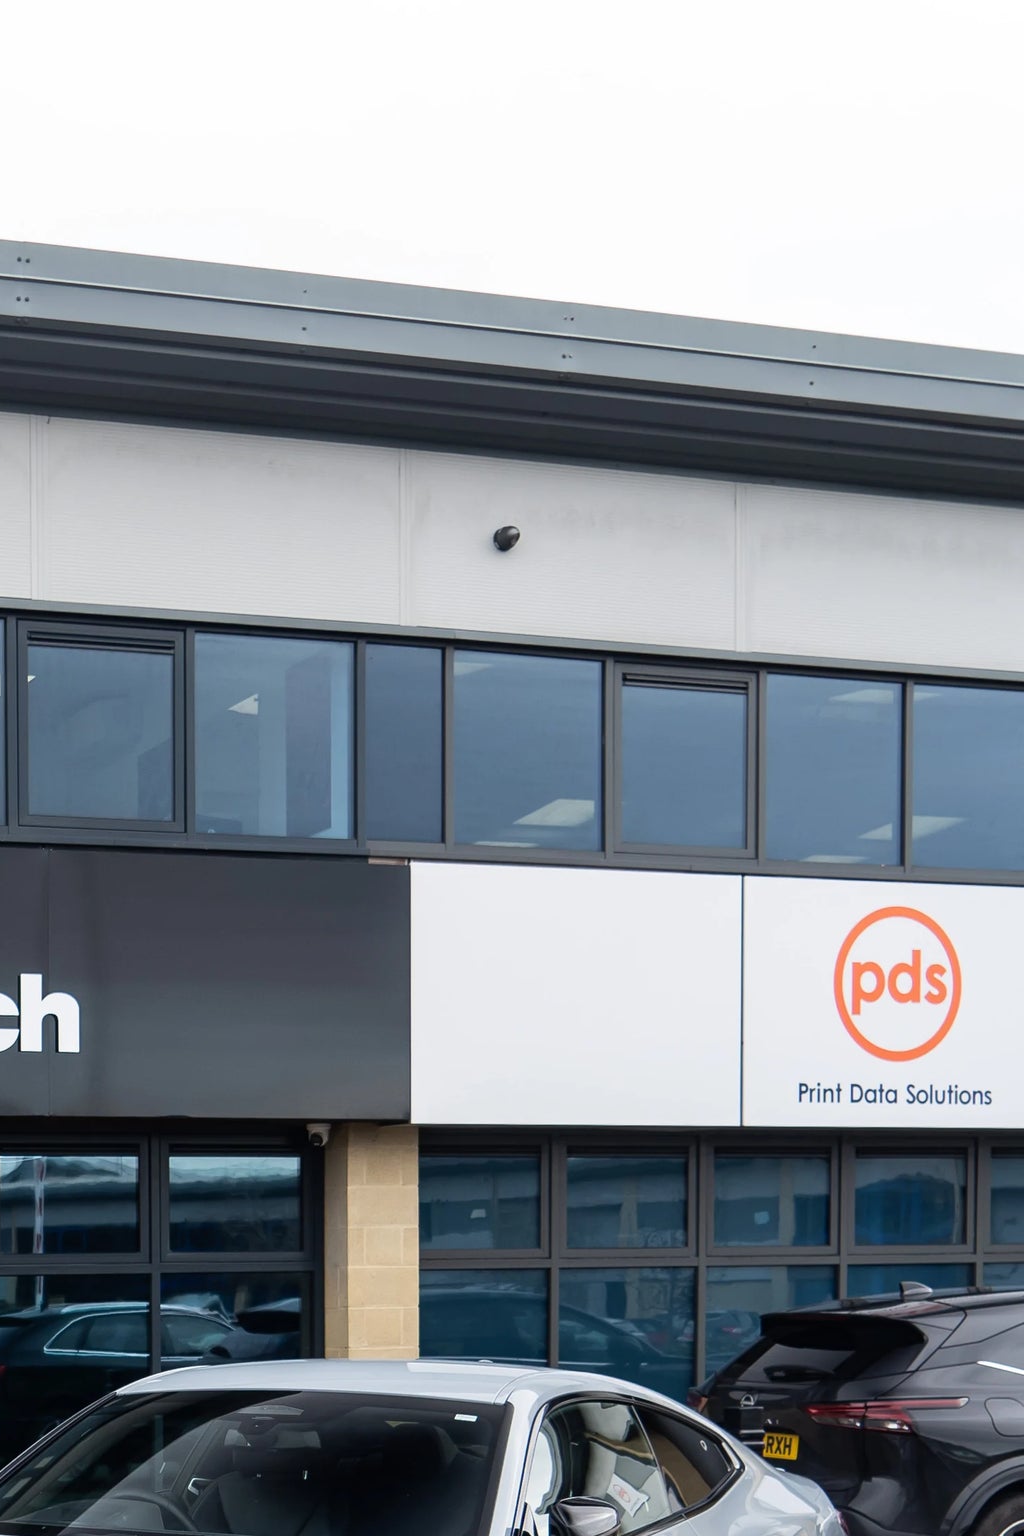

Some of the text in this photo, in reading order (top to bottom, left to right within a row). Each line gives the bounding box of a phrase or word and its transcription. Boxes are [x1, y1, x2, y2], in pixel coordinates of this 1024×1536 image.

[851, 949, 948, 1016] pds
[798, 1082, 993, 1105] Print Data Solutions
[766, 1435, 793, 1456] RXH
